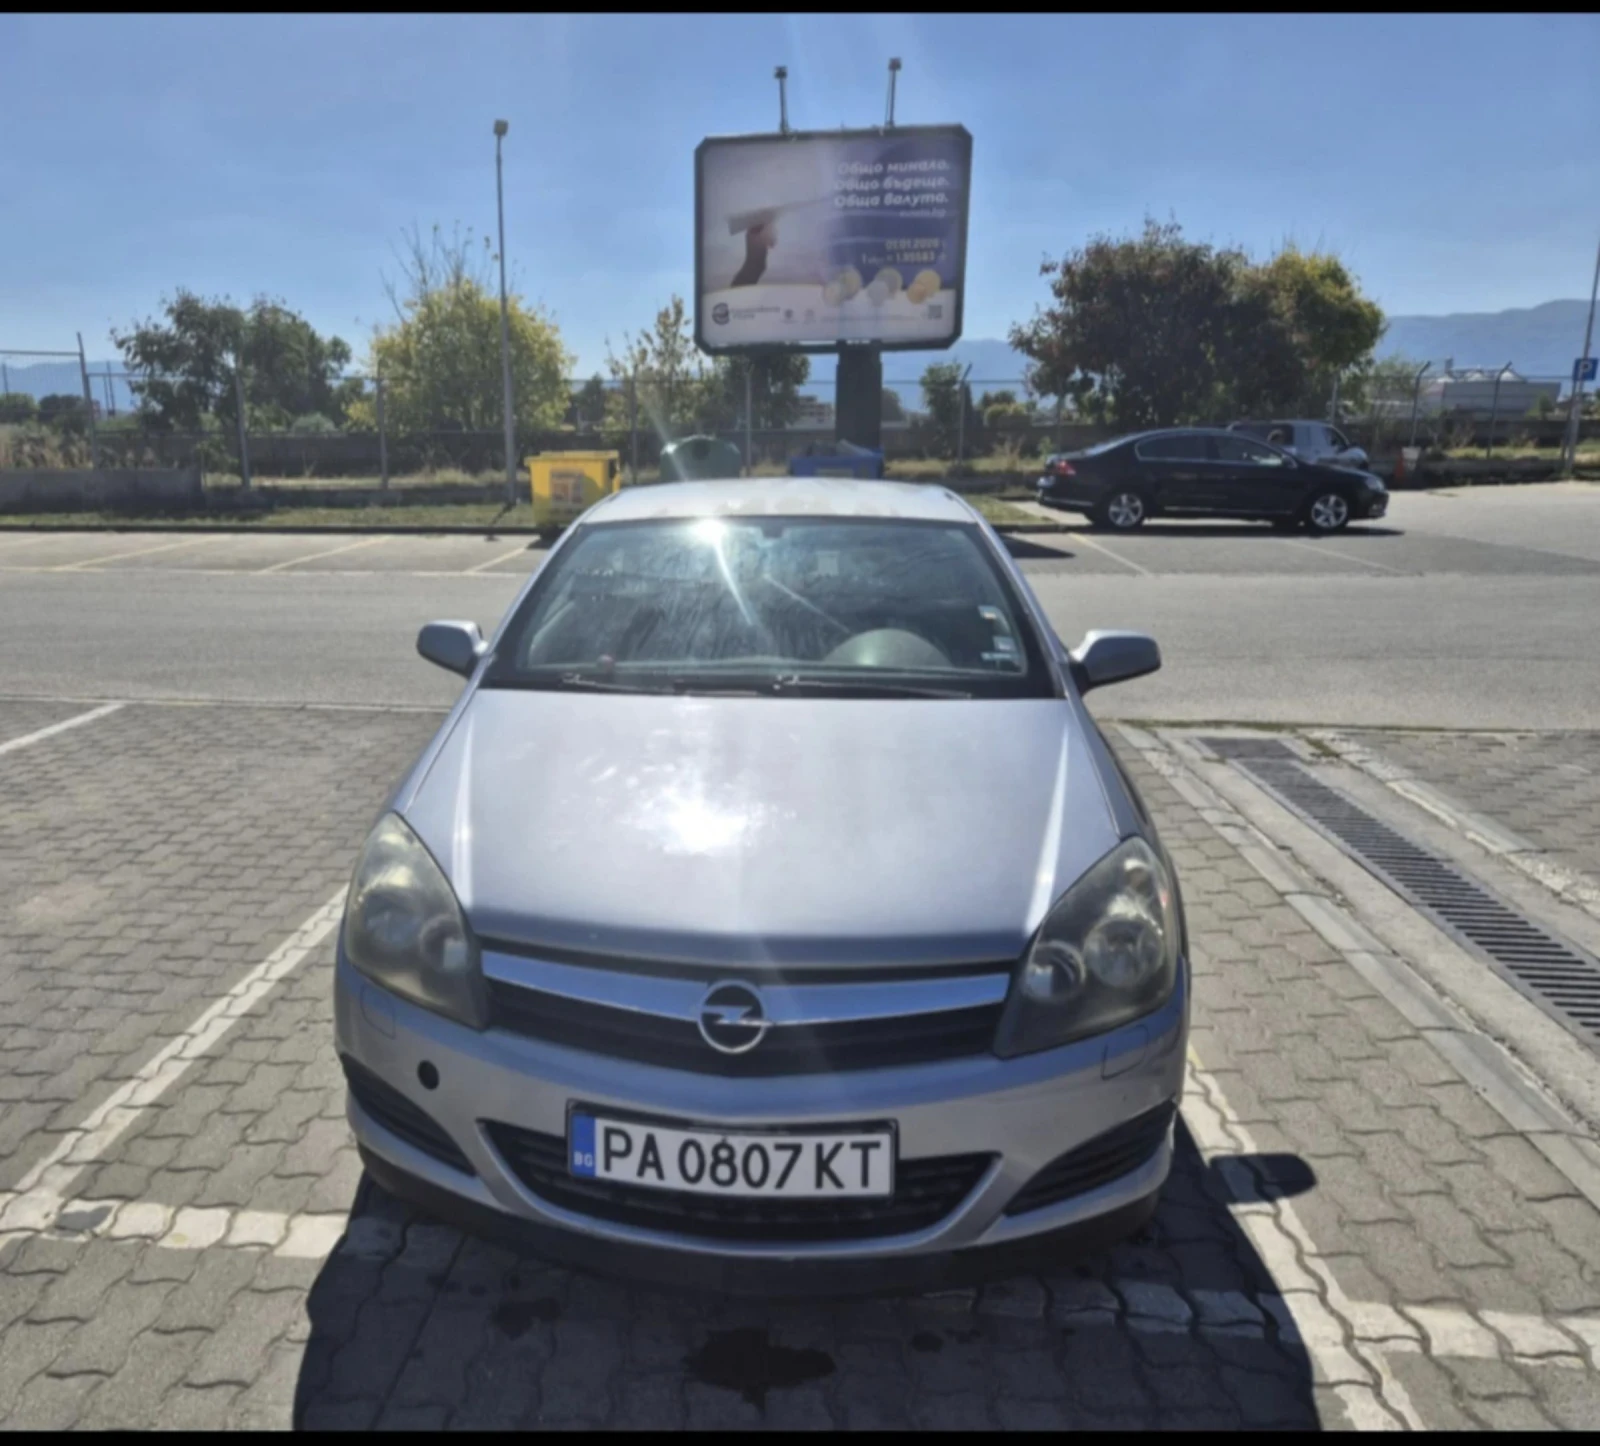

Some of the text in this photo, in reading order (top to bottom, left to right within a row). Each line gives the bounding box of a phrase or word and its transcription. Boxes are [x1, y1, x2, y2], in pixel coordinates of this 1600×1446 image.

[835, 192, 949, 207] Обща валута.
[1579, 361, 1593, 380] P
[574, 1151, 593, 1168] BG
[603, 1126, 881, 1189] PA 0807 KT
